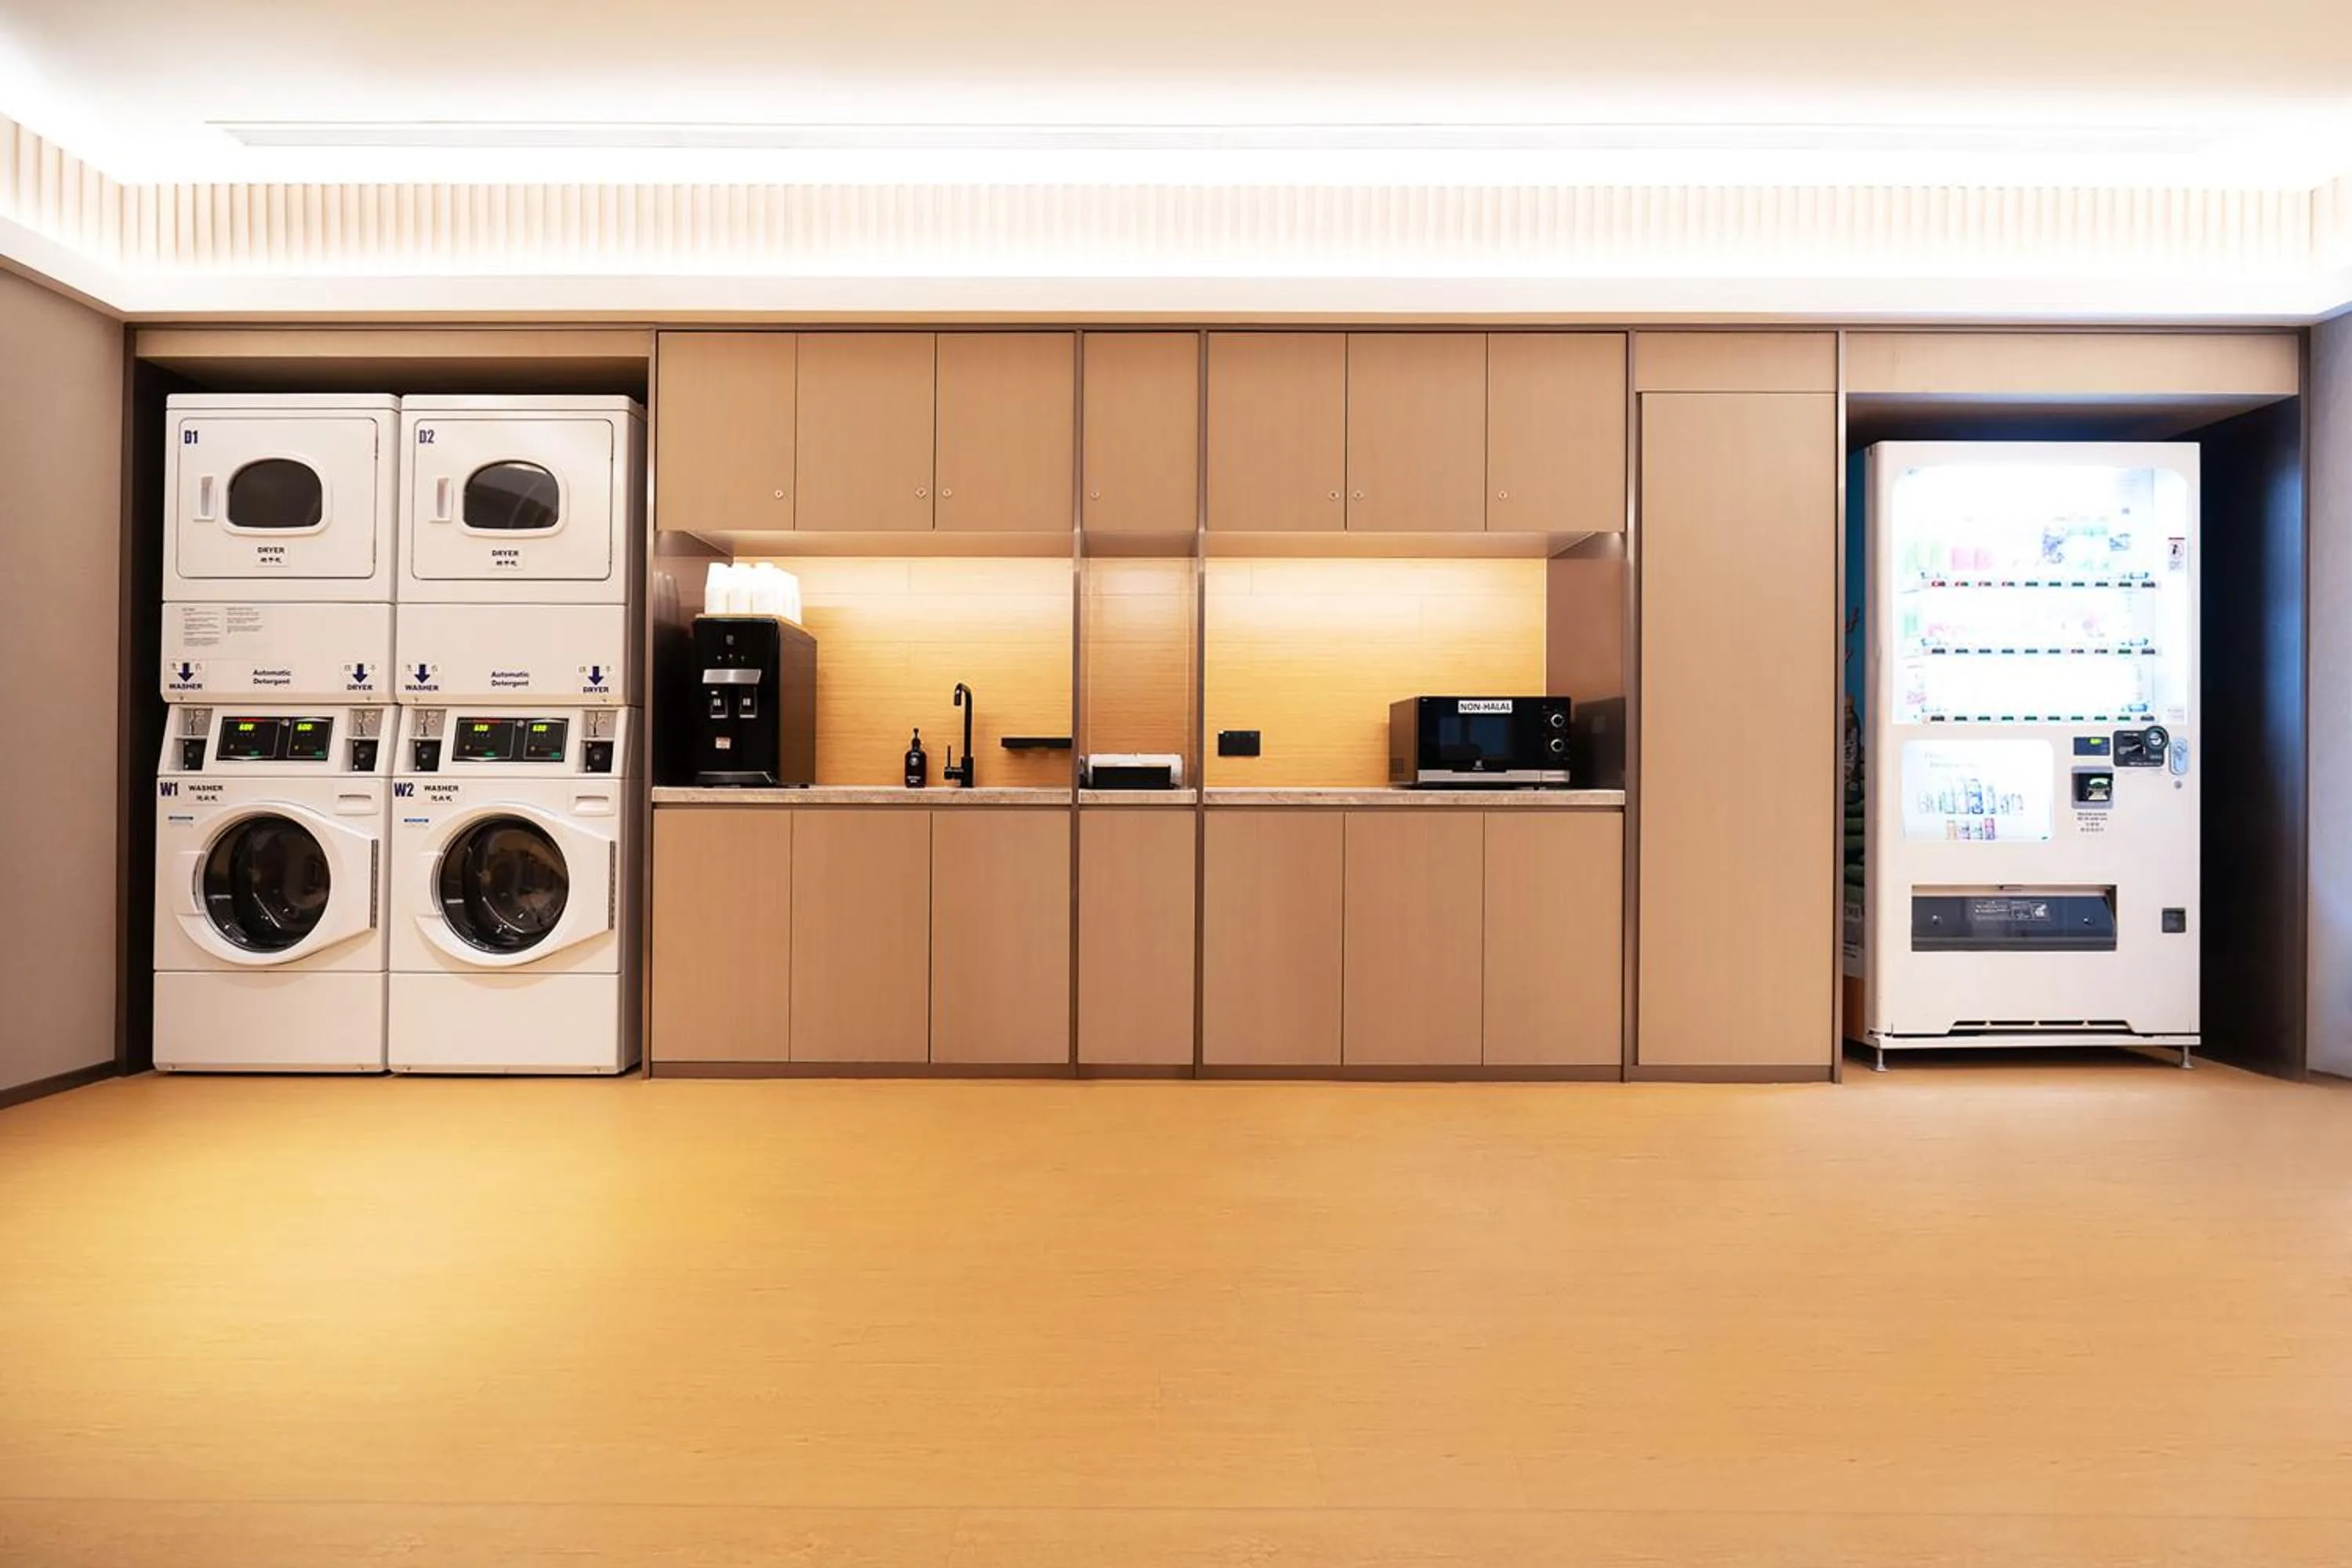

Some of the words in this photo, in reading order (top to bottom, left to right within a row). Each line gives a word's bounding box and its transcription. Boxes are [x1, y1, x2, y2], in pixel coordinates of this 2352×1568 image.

[184, 430, 198, 445] D1
[419, 429, 435, 444] D2
[1460, 702, 1511, 711] NON-HALAL
[160, 782, 179, 797] W1
[394, 782, 415, 797] W2
